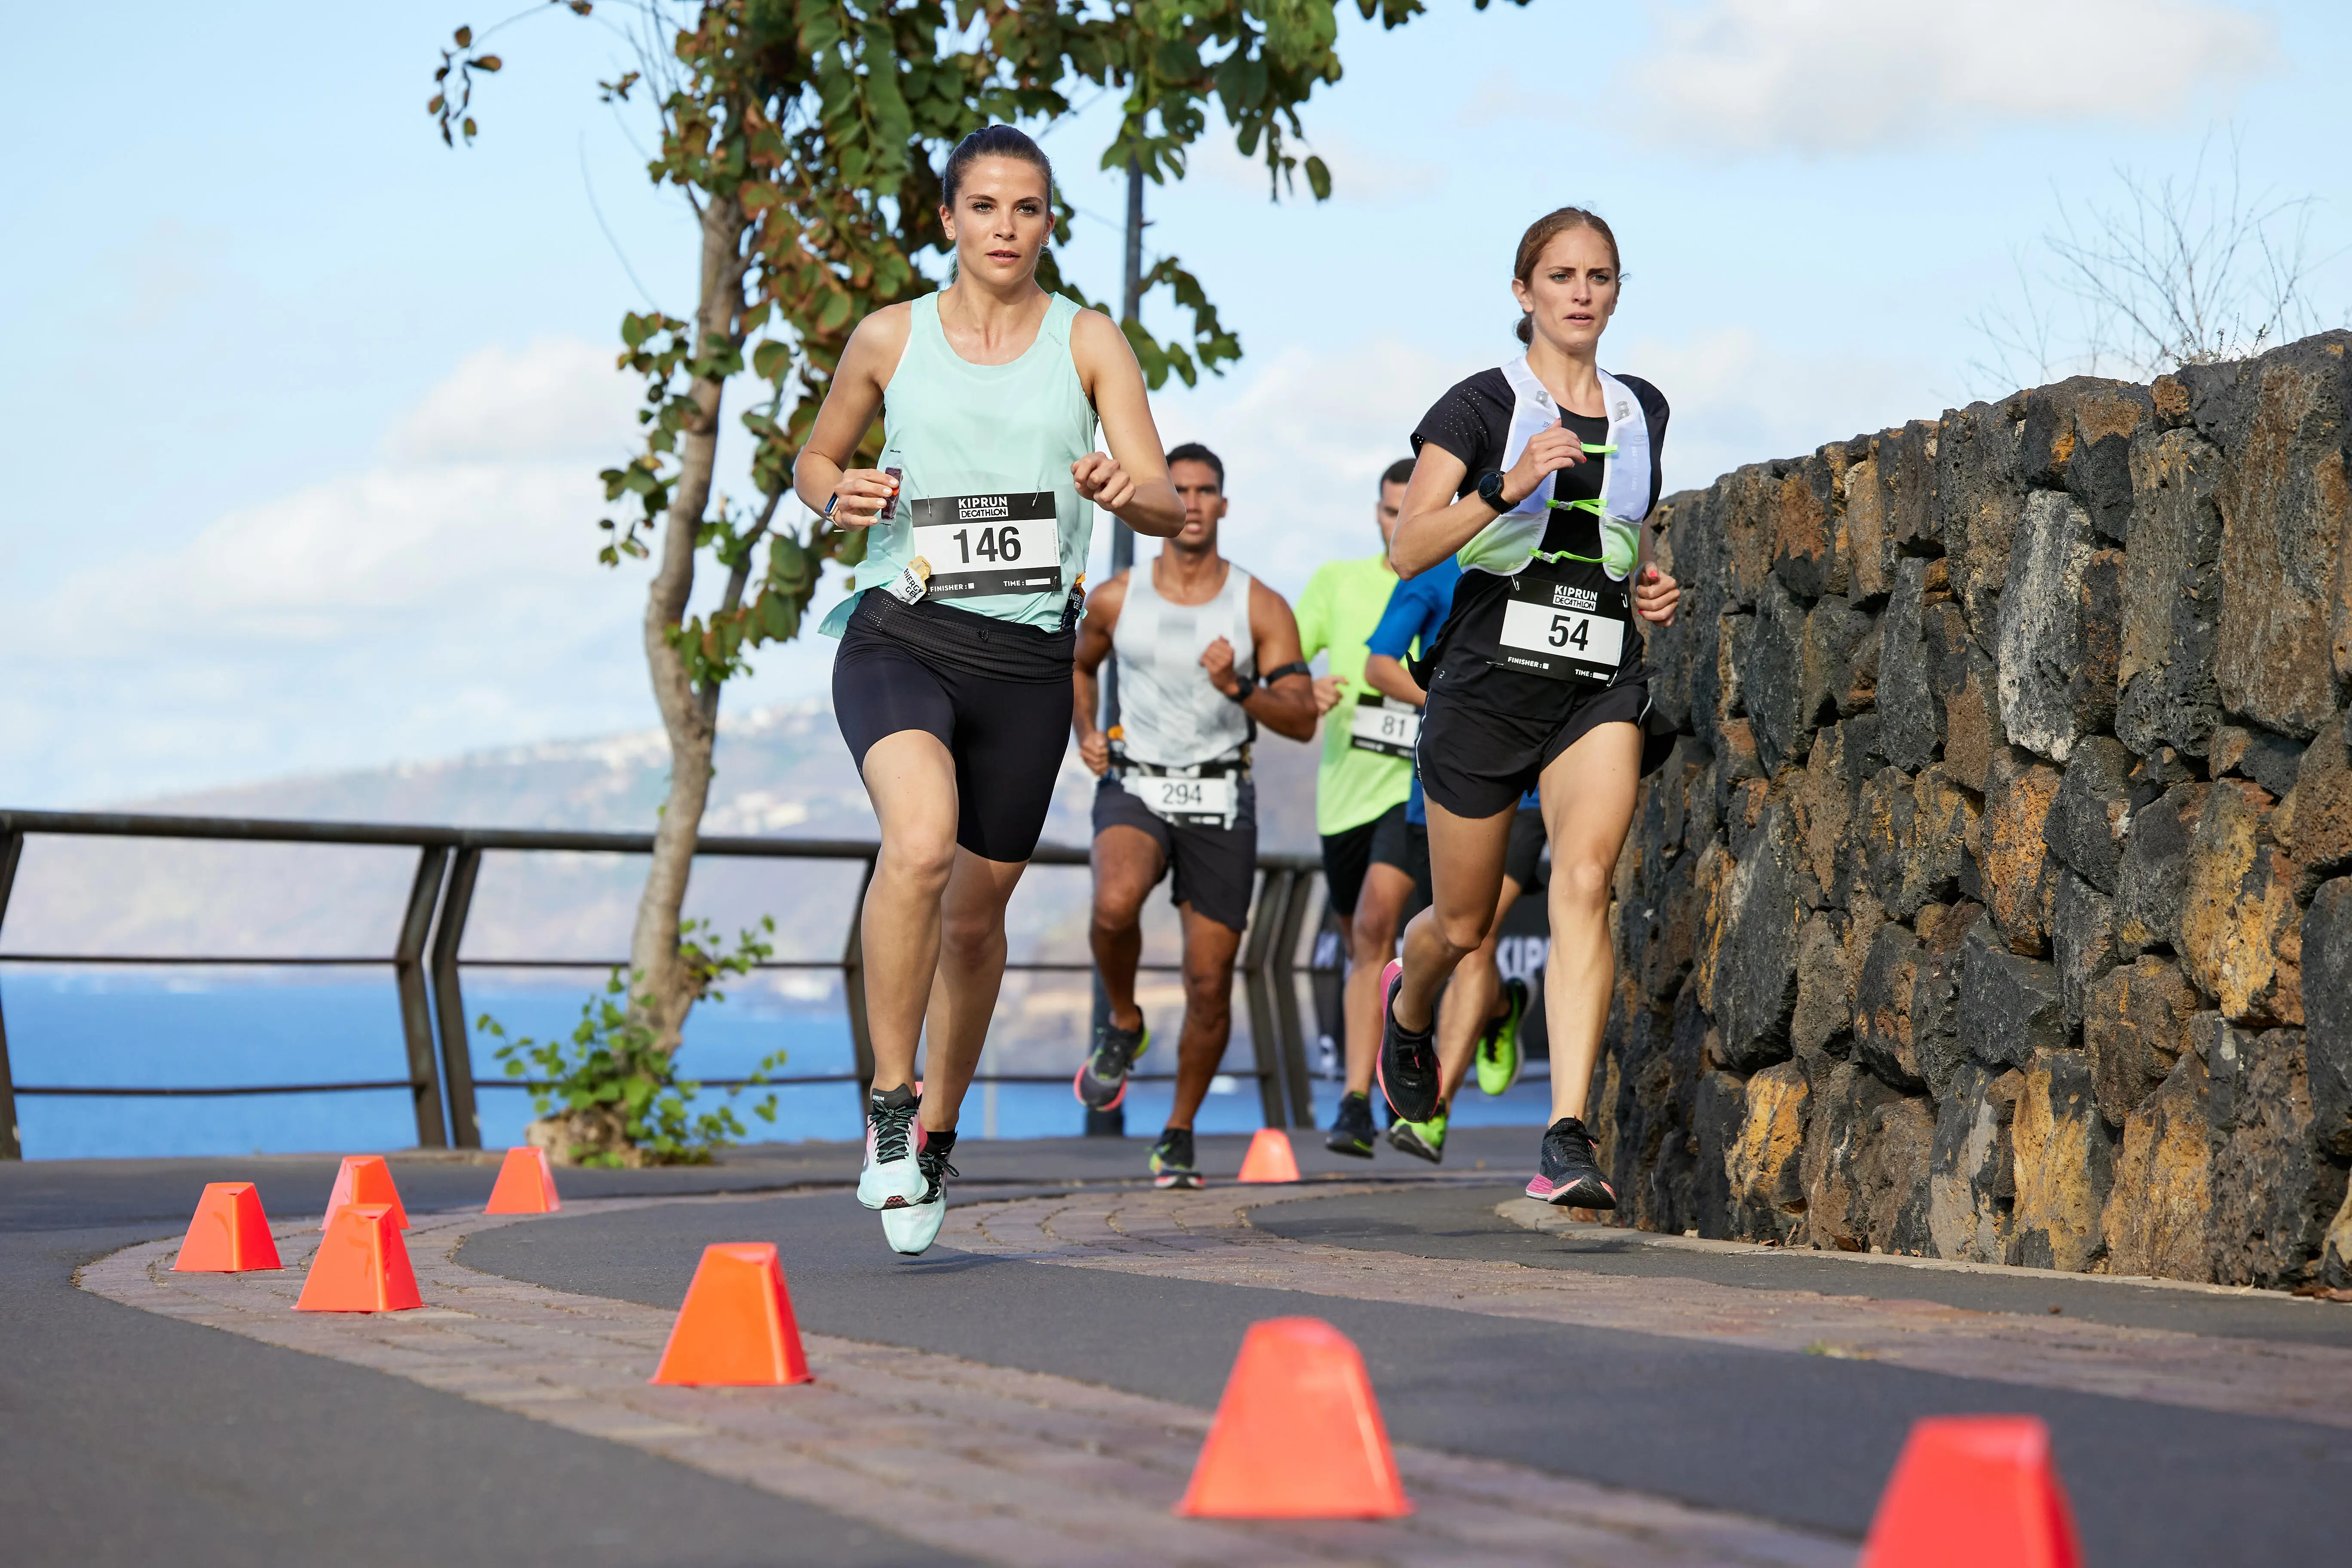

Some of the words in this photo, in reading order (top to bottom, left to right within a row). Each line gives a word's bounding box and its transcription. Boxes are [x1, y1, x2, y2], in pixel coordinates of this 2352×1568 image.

[1047, 331, 1063, 346] KIPRUN
[958, 496, 1008, 508] KIPRUN
[961, 508, 1007, 518] DECATHLON
[953, 526, 1021, 564] 146
[903, 568, 924, 594] ENERGY
[905, 586, 917, 598] GEL
[1554, 585, 1598, 601] KIPRUN
[1555, 596, 1594, 609] DECATHLON
[1548, 614, 1589, 651] 54
[1381, 715, 1406, 738] 81
[1162, 783, 1201, 805] 294
[1495, 936, 1550, 982] KIP
